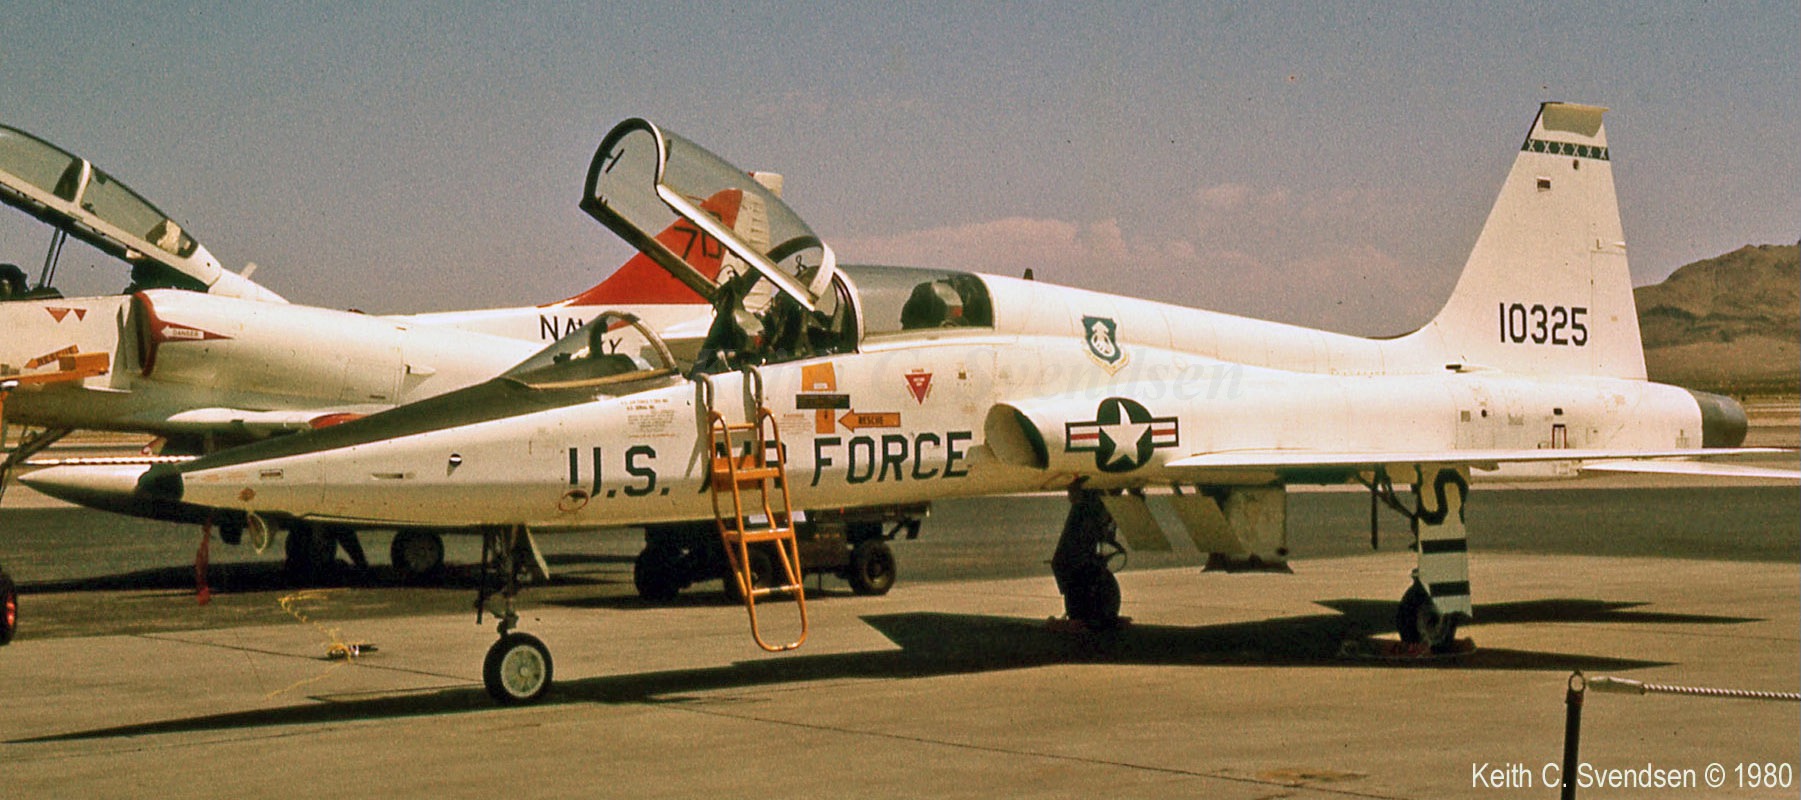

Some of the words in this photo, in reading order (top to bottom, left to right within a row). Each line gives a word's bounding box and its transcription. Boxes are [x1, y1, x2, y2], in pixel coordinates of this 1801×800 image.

[540, 314, 622, 354] NAY
[1500, 302, 1588, 346] 10325
[569, 445, 670, 498] U.S.
[811, 431, 972, 487] FORCE
